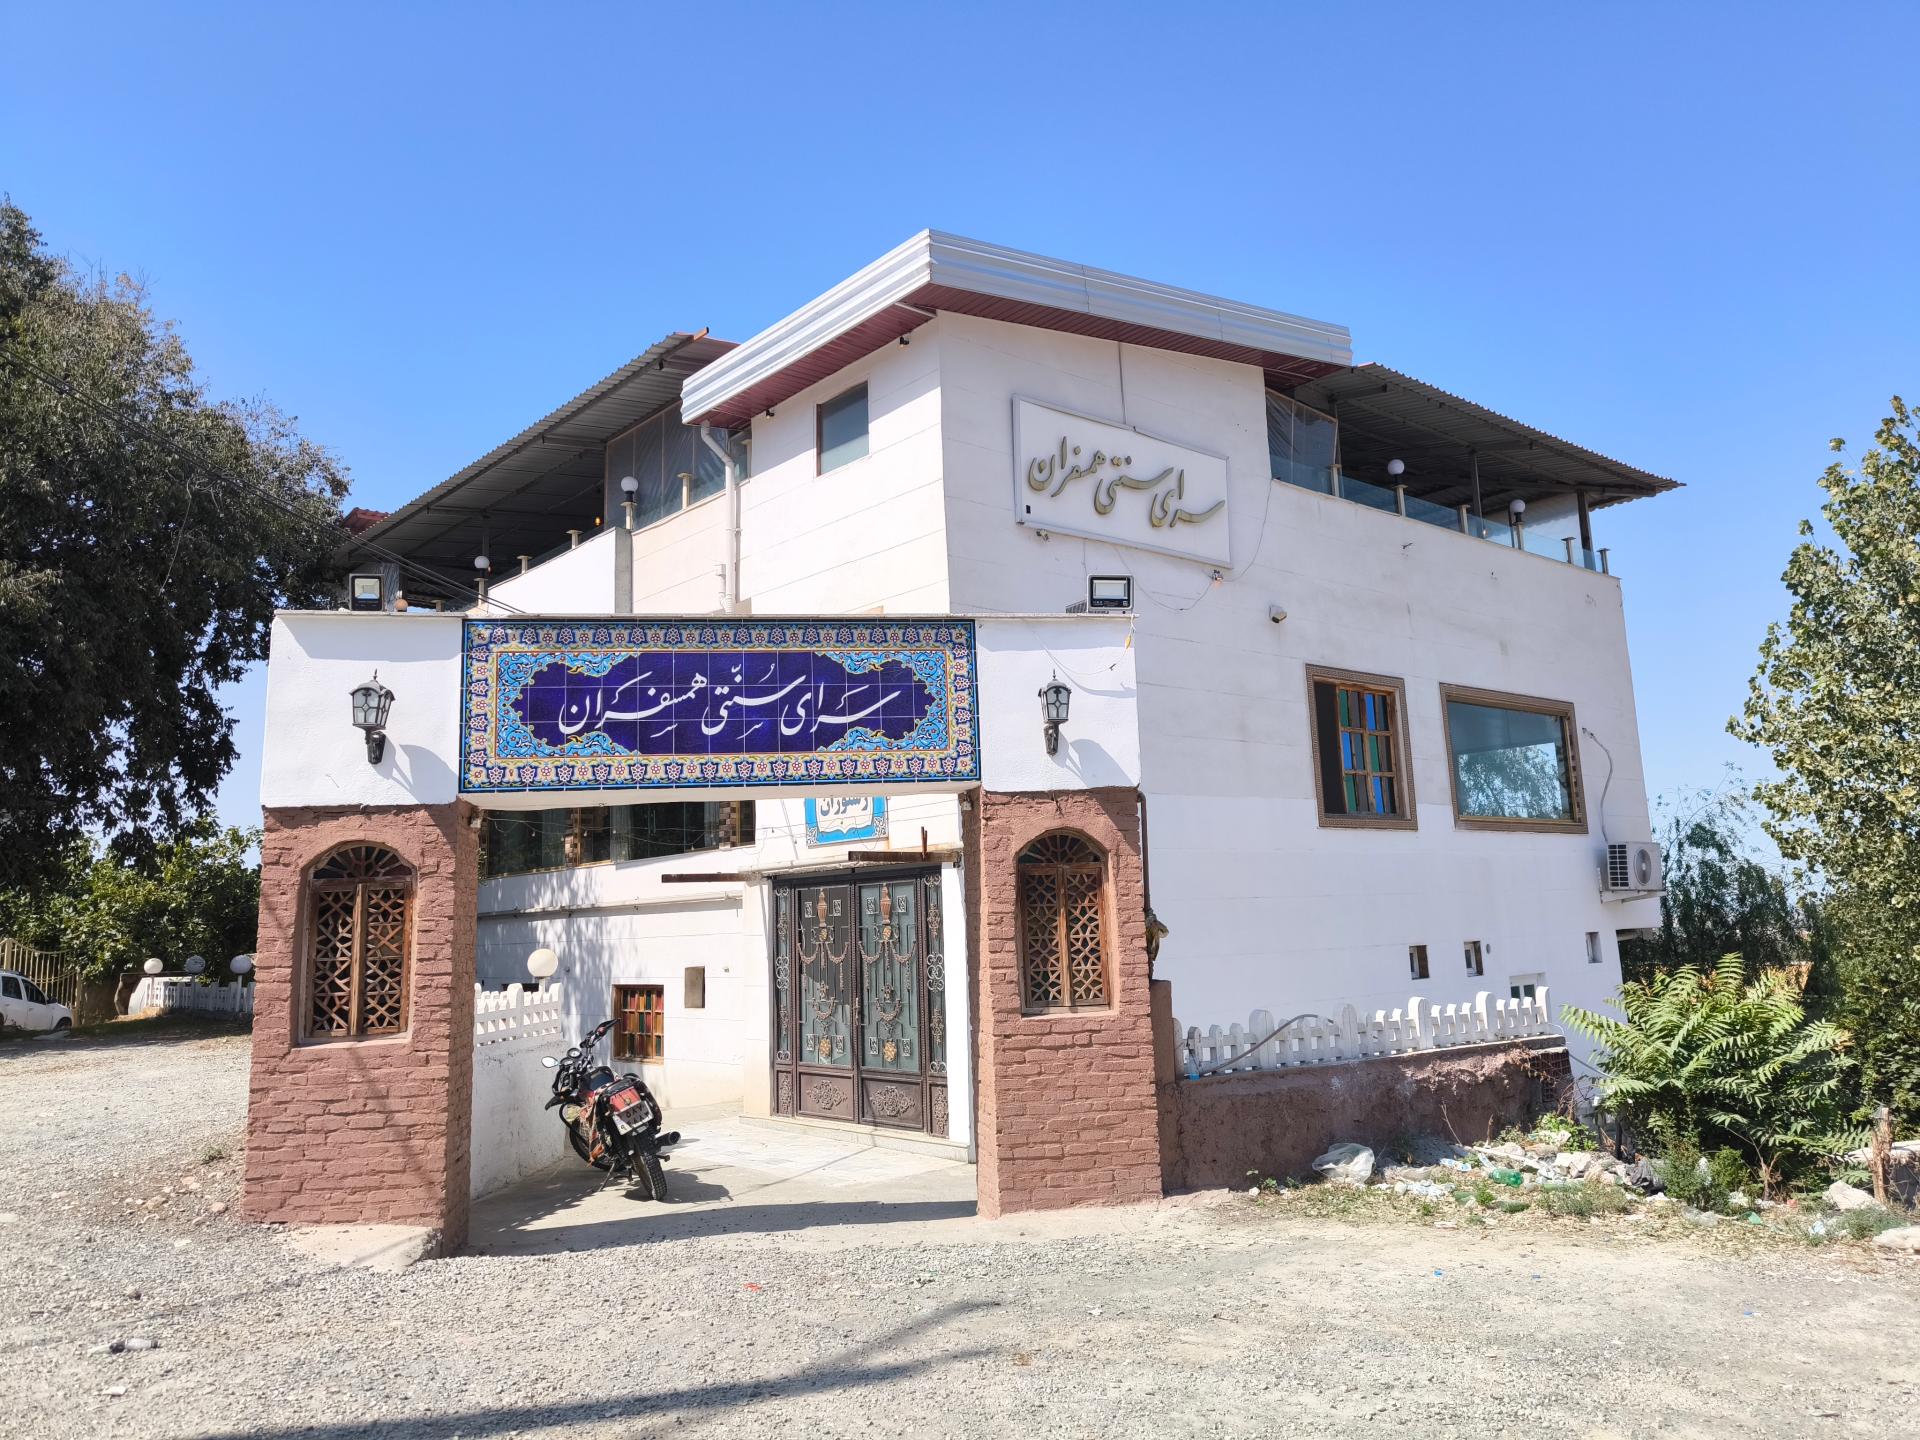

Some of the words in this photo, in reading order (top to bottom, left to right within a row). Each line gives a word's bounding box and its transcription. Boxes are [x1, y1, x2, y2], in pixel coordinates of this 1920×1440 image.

[1094, 455, 1174, 515] سنتی
[1151, 469, 1226, 528] سرای
[558, 671, 707, 735] همسفران
[780, 681, 901, 736] سرای
